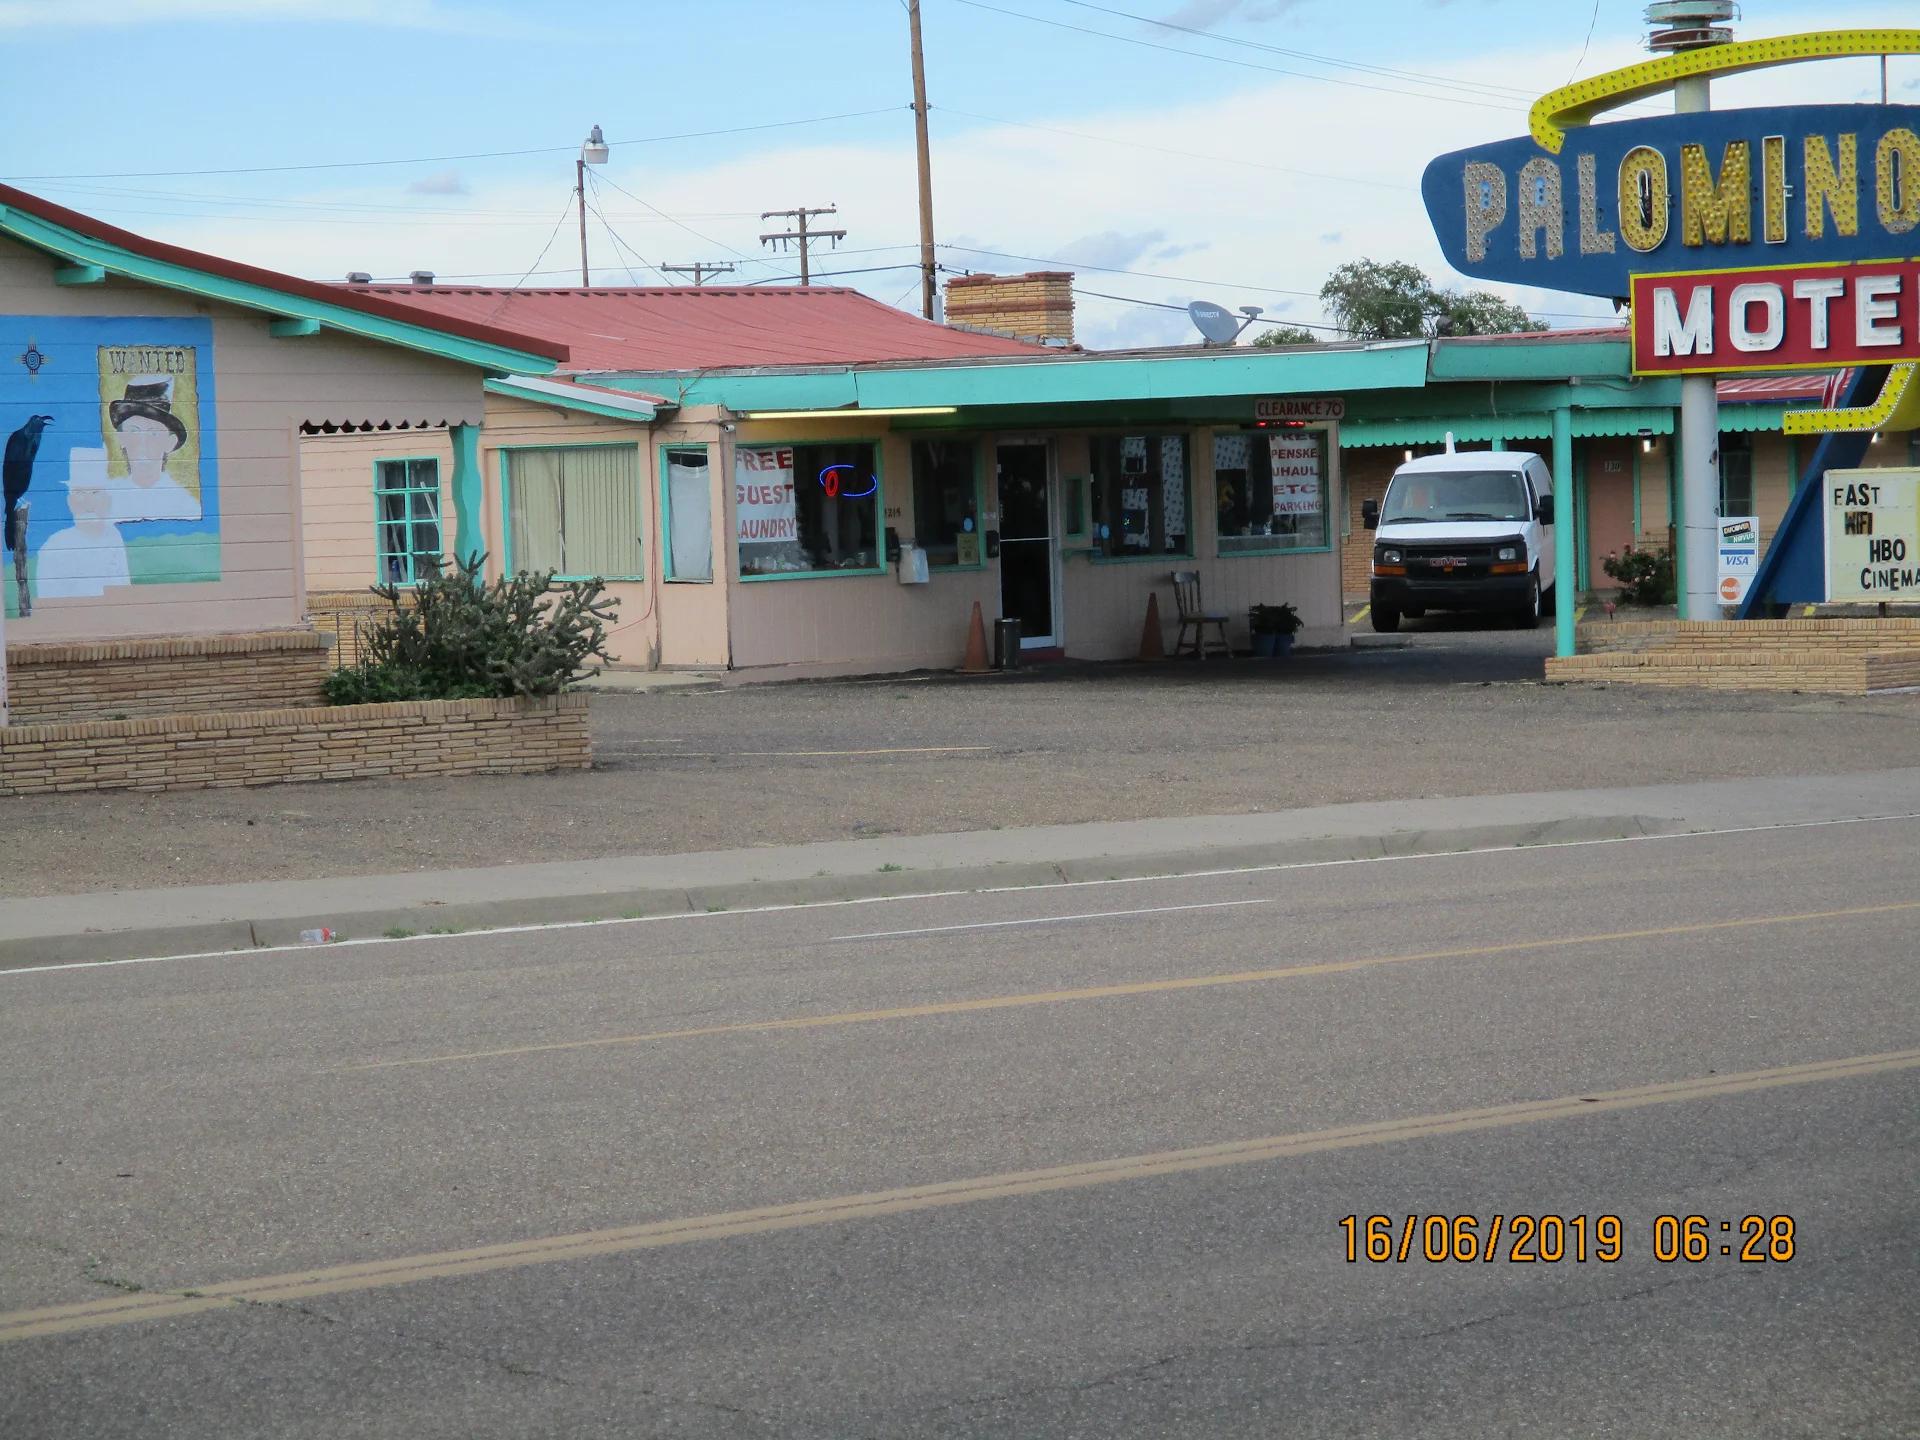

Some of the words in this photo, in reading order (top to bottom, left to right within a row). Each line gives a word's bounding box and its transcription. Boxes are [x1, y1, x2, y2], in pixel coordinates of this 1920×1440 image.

[1464, 128, 1920, 262] PALOMINO
[1654, 273, 1920, 357] MOTE
[109, 350, 185, 374] WANTED
[1257, 401, 1322, 416] CLEARANCE
[735, 450, 793, 471] FREE
[736, 484, 794, 505] GUEST
[1273, 484, 1317, 495] ETC
[1274, 500, 1323, 512] PARKING
[738, 517, 796, 539] AUNDRY
[1733, 532, 1755, 543] NOVUS
[1726, 556, 1749, 565] VISA
[1870, 539, 1906, 563] HBO
[1430, 557, 1467, 567] GMC
